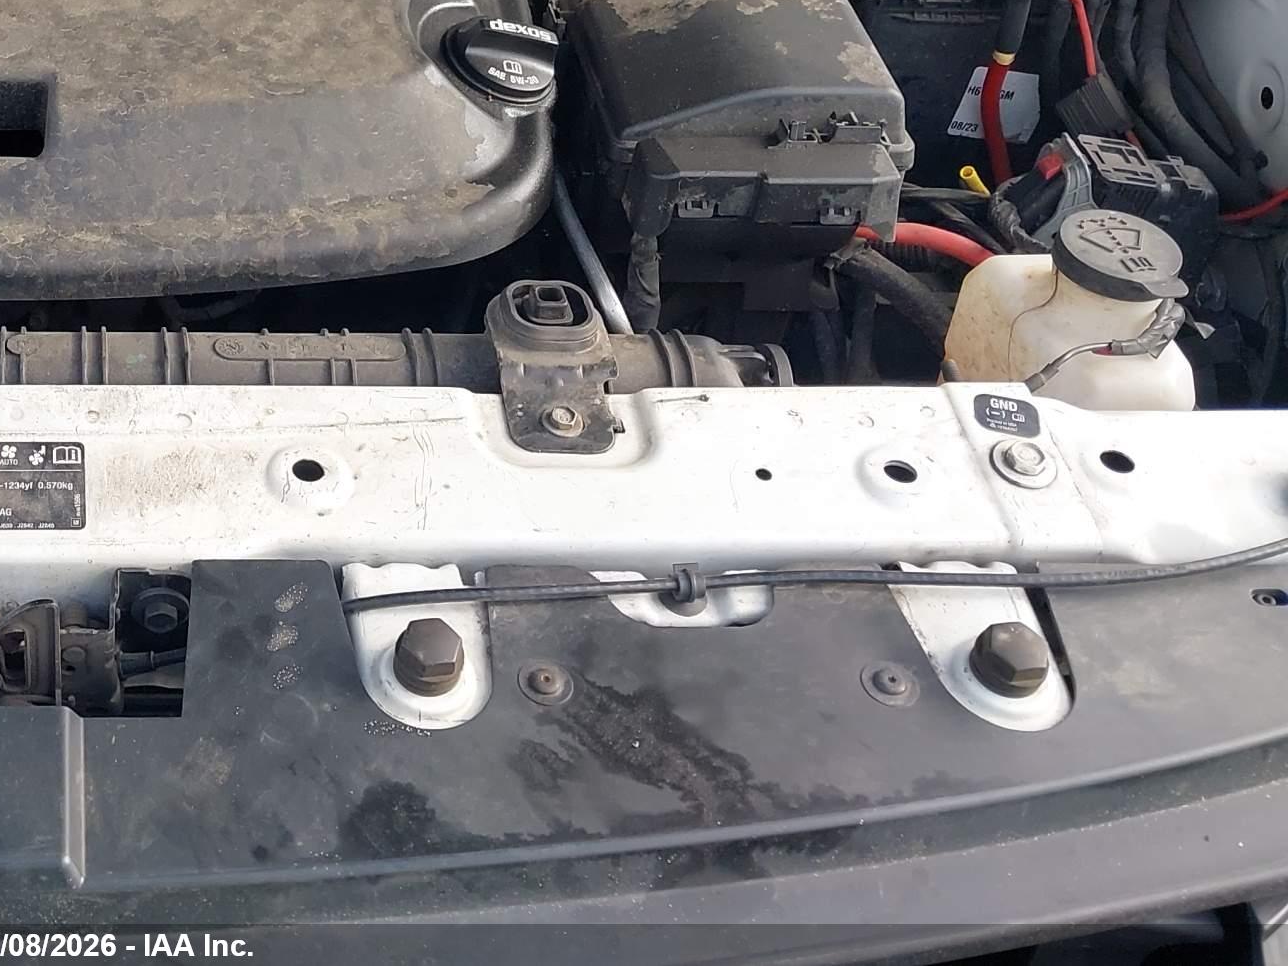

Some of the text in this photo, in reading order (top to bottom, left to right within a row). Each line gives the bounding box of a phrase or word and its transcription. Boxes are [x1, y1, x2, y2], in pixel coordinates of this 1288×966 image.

[489, 19, 552, 41] dexos
[488, 67, 506, 81] SAE
[951, 121, 978, 132] 08/23
[990, 398, 1017, 412] GND
[38, 482, 73, 491] 0.570kg
